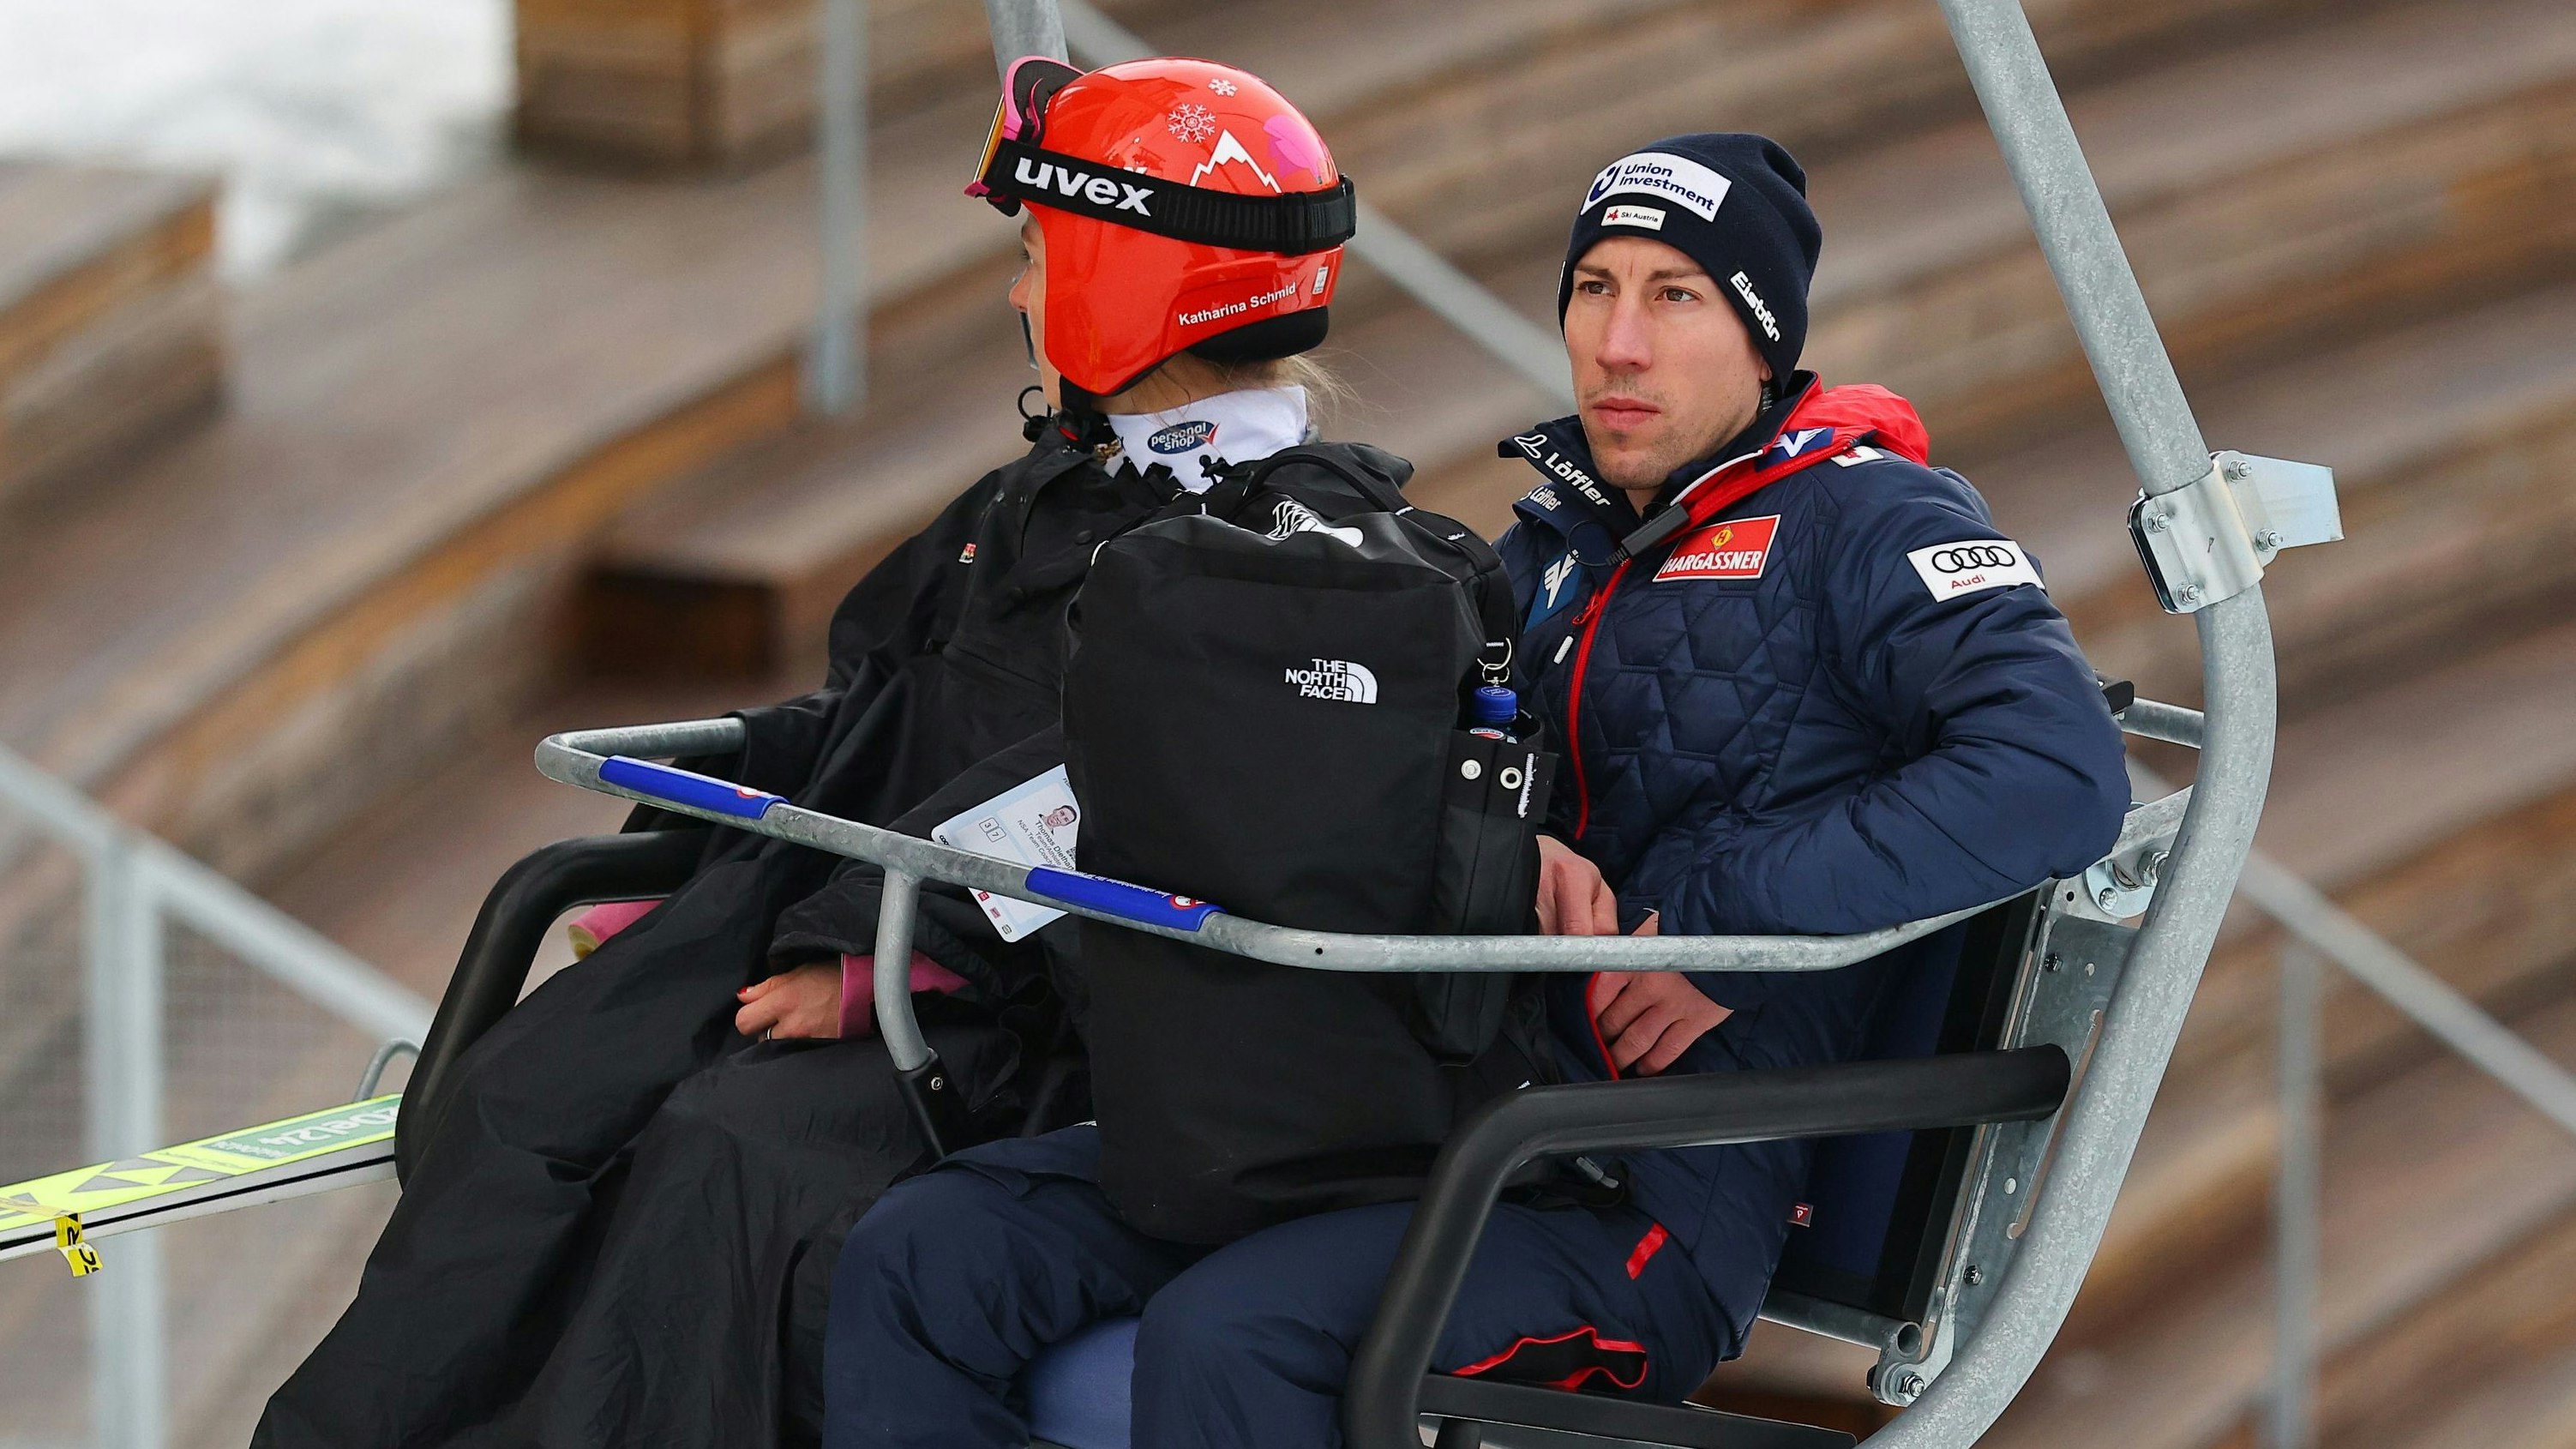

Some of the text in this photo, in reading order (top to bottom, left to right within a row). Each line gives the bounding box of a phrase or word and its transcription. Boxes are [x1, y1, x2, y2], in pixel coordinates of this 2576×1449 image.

[1624, 163, 1672, 177] Union
[1015, 157, 1155, 217] uvex
[1618, 176, 1714, 211] Investment
[1633, 213, 1658, 223] Austria
[1179, 281, 1296, 326] Katharina Schmid
[1730, 270, 1780, 342] Eisbär
[1150, 422, 1207, 448] personal
[1164, 435, 1195, 451] shop
[1545, 452, 1611, 506] Löffler
[1661, 550, 1763, 574] HARGASSNER
[1951, 574, 1986, 589] Audi
[1285, 668, 1346, 688] NORTH
[1312, 658, 1346, 673] THE
[1300, 684, 1344, 700] FACE
[1017, 819, 1029, 833] NSA
[1028, 832, 1040, 848] Team
[1036, 820, 1055, 846] Thomas
